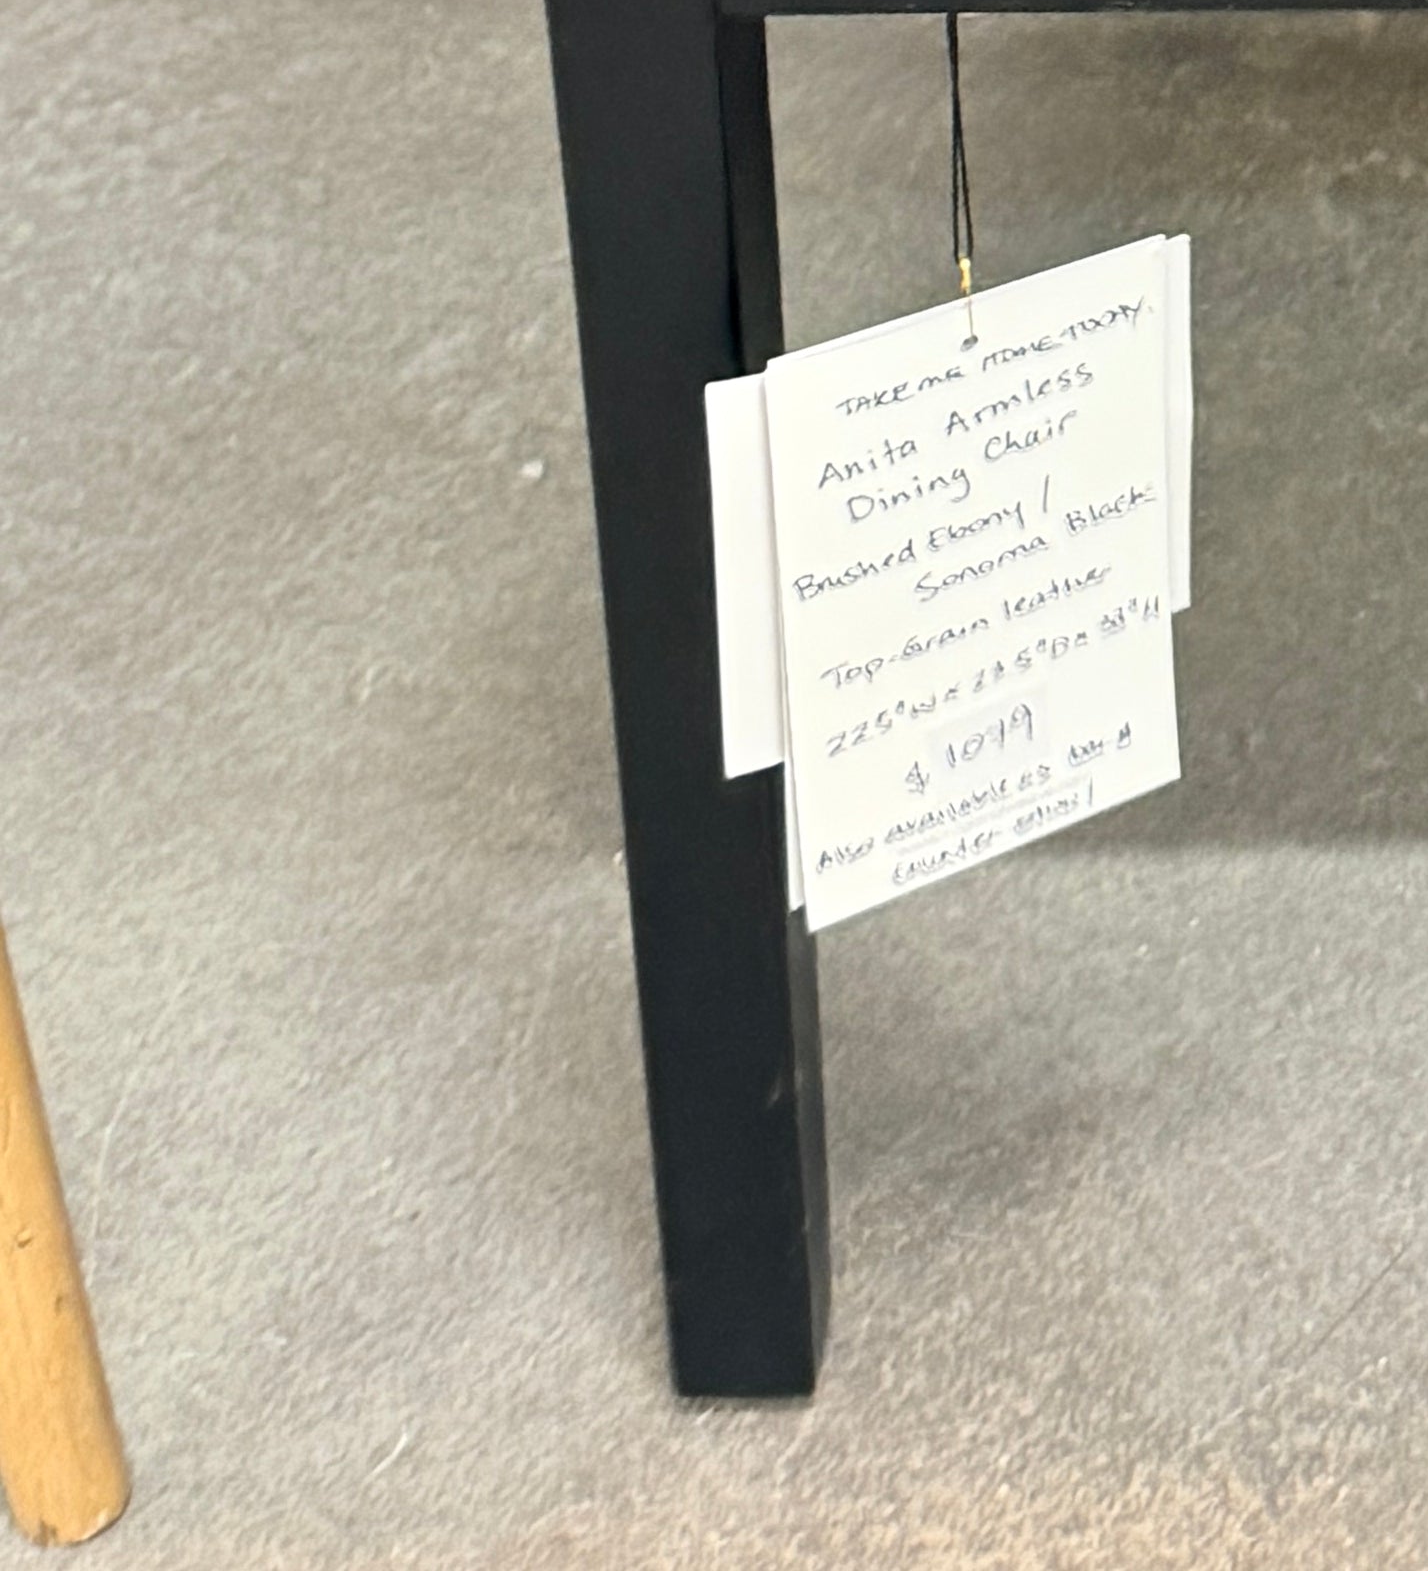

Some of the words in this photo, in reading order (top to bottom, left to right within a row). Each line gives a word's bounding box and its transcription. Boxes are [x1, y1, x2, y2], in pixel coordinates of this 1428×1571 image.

[817, 438, 918, 489] Anita
[946, 363, 1093, 437] Armless
[846, 466, 970, 522] Dining
[984, 410, 1077, 461] Chair
[792, 539, 917, 601] Brushed
[928, 501, 1025, 553] Ebony
[914, 535, 1050, 603] Sonoma
[1066, 482, 1157, 537] Black
